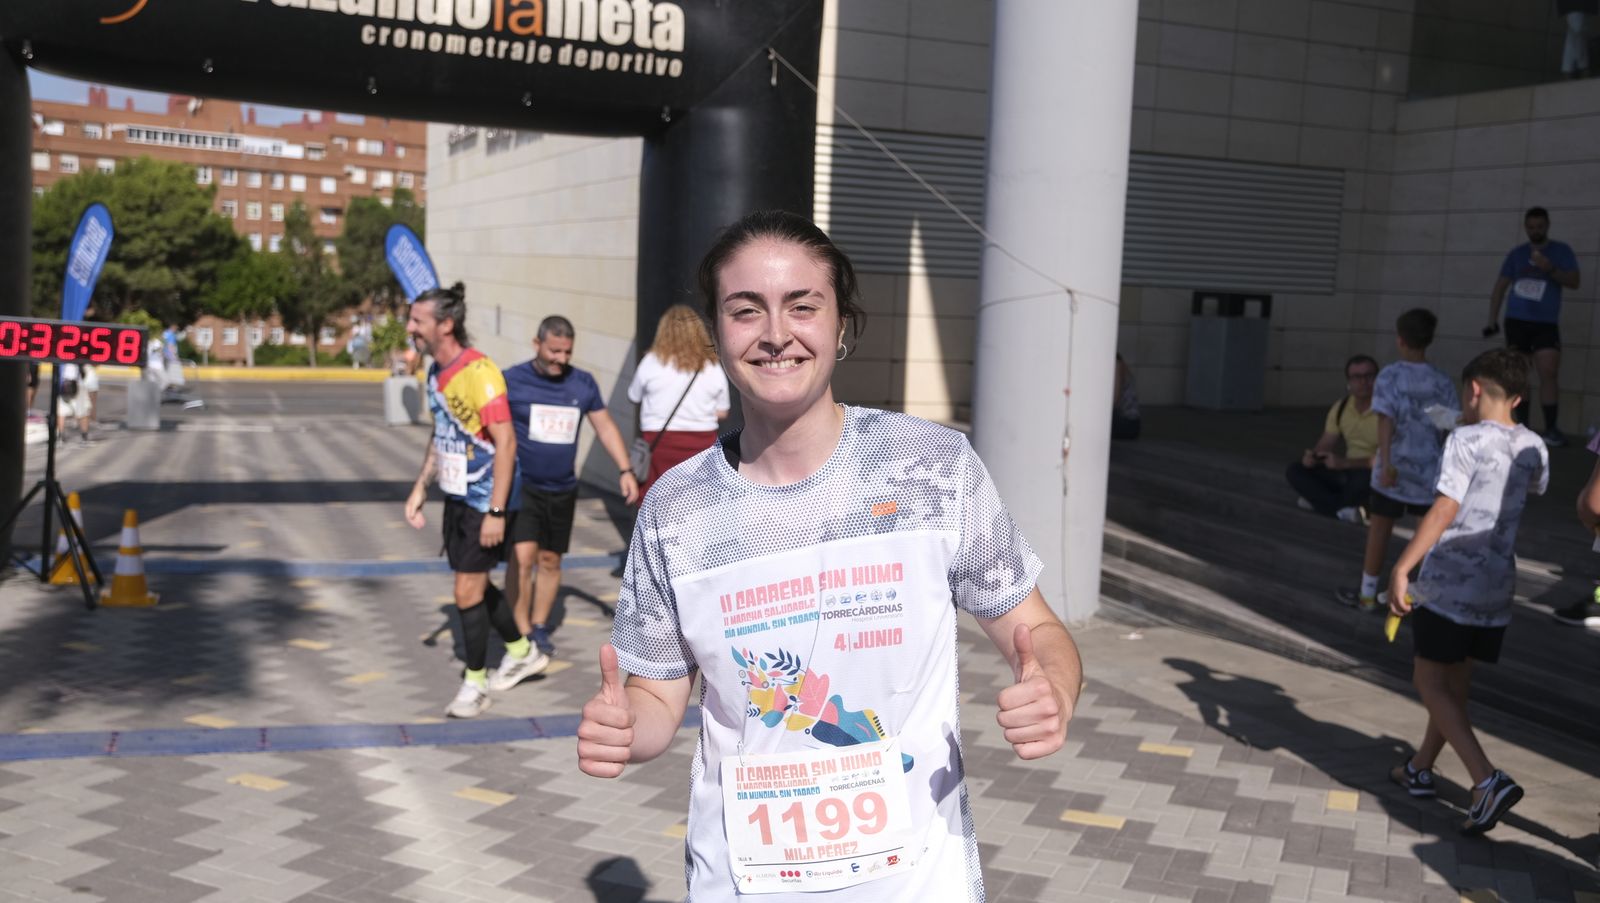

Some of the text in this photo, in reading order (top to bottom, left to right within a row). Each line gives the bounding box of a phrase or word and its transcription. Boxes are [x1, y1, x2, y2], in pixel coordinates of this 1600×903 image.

[361, 24, 683, 77] cronometraje deportivo
[0, 321, 141, 363] 0:32:58
[720, 562, 904, 613] II CARRERA SIN HUMO
[724, 610, 820, 639] DÍA MUNDIAL SIN TABACO
[730, 609, 763, 625] MARCHA
[764, 599, 816, 618] SALUDABLE
[821, 603, 903, 620] TORRECÁRDENAS
[834, 627, 903, 651] 4 JUNIO
[736, 751, 882, 782] II CARRERA SIN HUMO
[743, 781, 773, 790] MARCHA
[773, 777, 818, 789] SALUDABLE
[749, 789, 778, 800] MUNDIAL
[779, 789, 792, 798] SIN
[793, 786, 821, 797] TABACO
[748, 792, 888, 846] 1199
[784, 845, 815, 861] MILA
